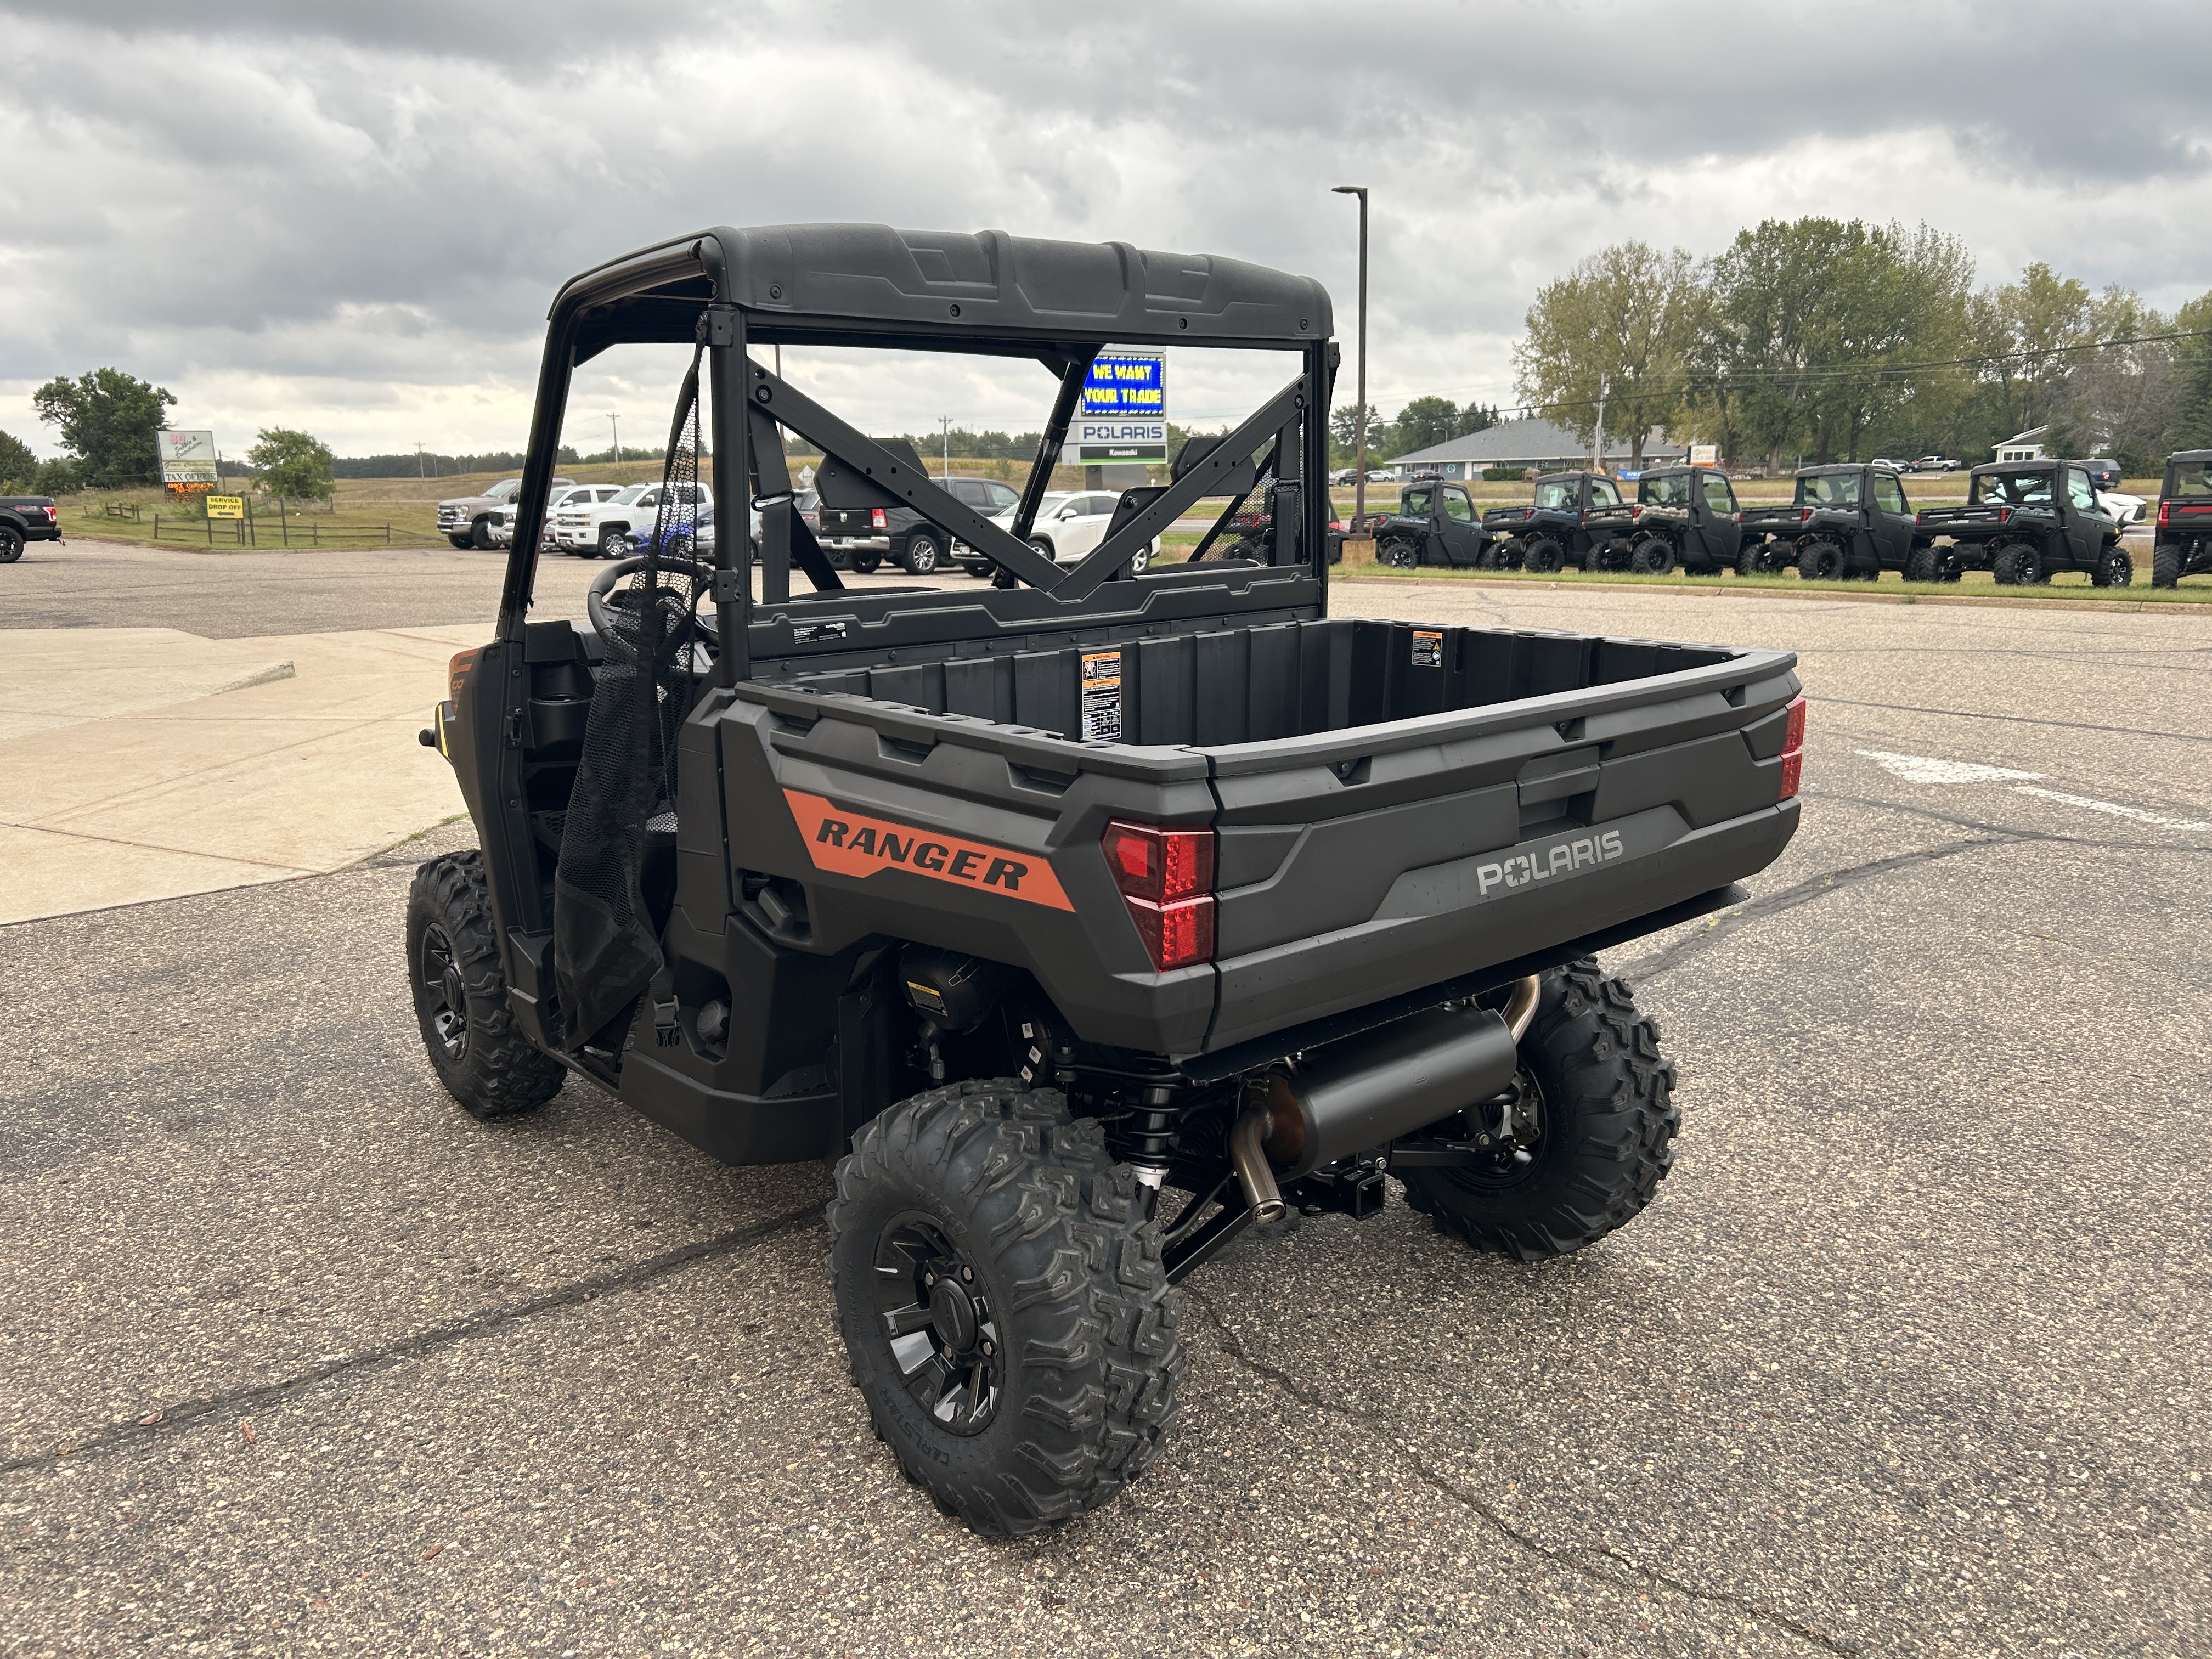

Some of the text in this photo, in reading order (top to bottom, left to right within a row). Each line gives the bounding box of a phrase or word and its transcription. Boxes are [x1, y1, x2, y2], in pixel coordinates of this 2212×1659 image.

[1092, 364, 1152, 380] WE WANT
[1084, 388, 1161, 404] YOUR TRADE
[1084, 426, 1163, 439] POLARIS
[165, 473, 216, 481] TAX OFFICE
[816, 818, 1029, 891] RANGER
[1476, 830, 1623, 895] POLARIS
[879, 1387, 950, 1467] CARLSTAR
